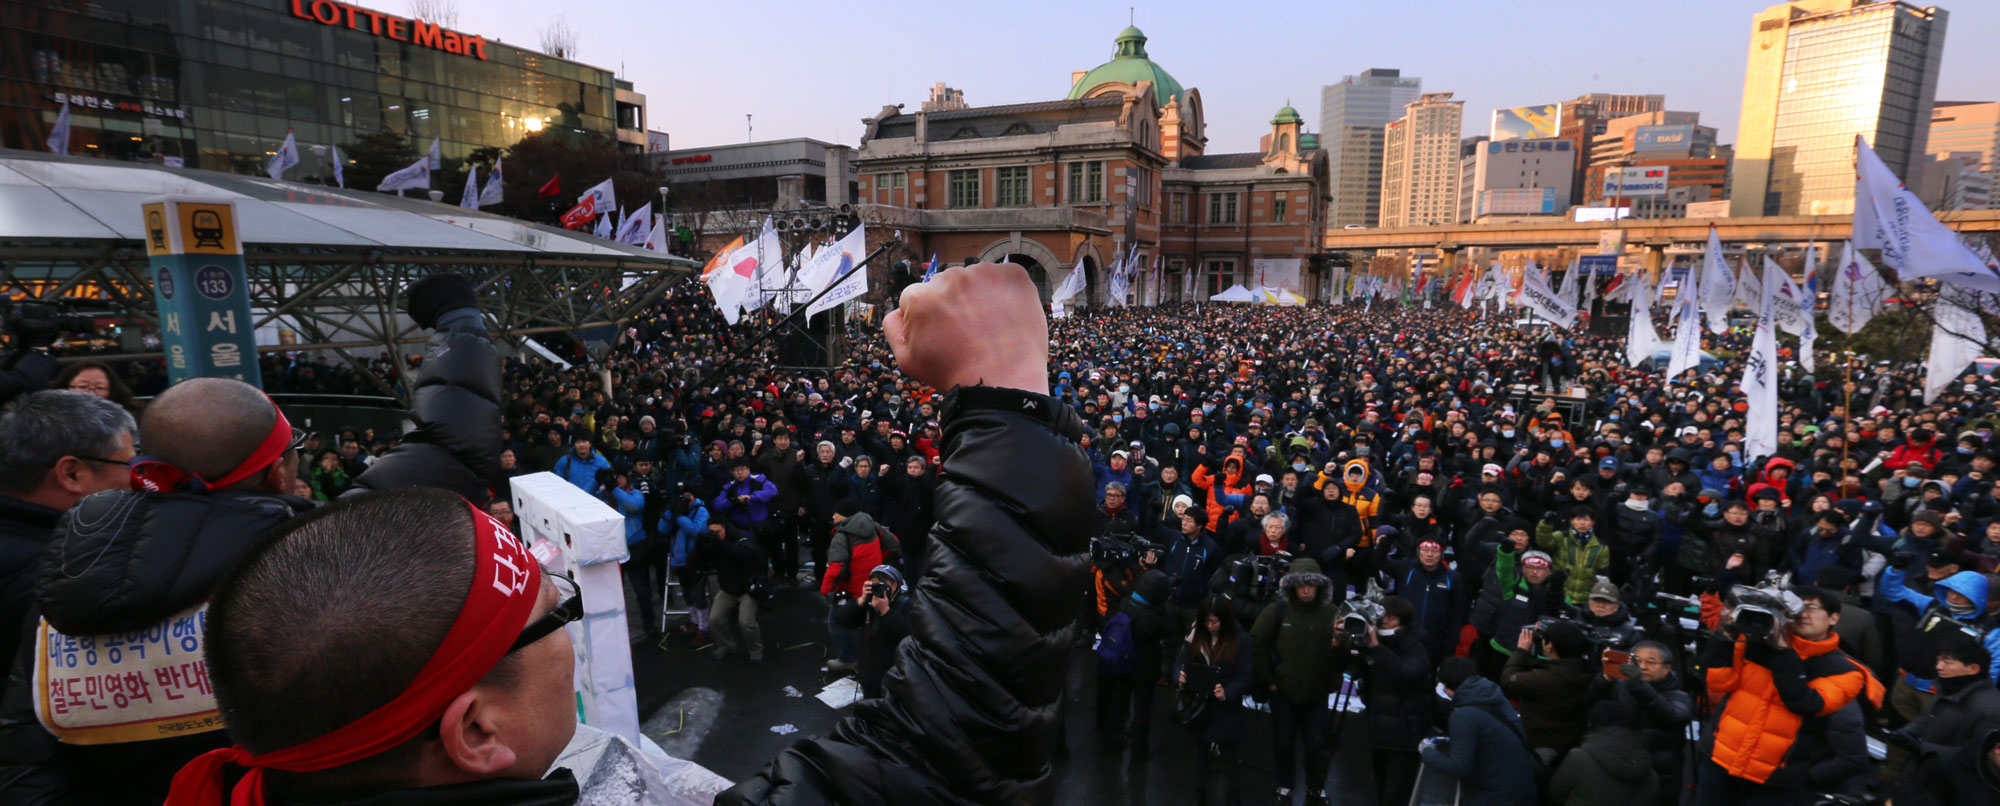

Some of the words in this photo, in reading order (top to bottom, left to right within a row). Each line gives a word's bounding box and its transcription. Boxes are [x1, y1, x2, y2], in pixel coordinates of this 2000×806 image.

[290, 0, 409, 42] LOTTE
[413, 18, 488, 60] Mart
[1657, 133, 1684, 143] BASF
[1605, 182, 1665, 192] Panasonic
[201, 279, 228, 294] 133
[206, 309, 244, 382] 서울
[50, 669, 153, 715] 철도민영화
